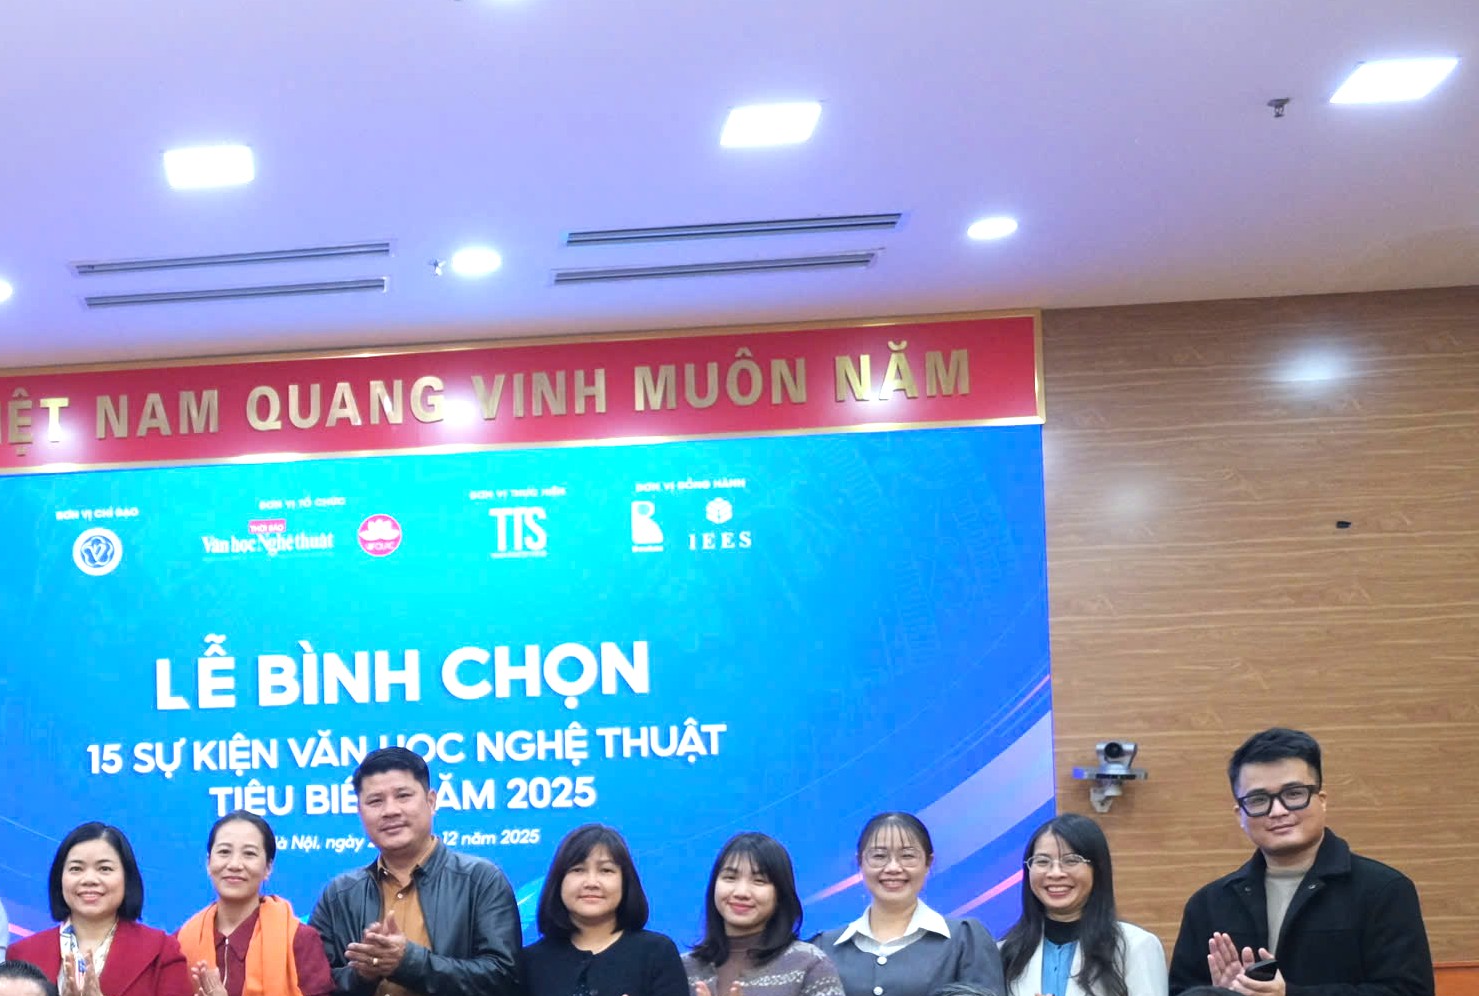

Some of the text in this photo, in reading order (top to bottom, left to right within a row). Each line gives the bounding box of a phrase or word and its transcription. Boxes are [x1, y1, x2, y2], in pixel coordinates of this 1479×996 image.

[96, 389, 218, 440] NAM
[245, 376, 445, 431] QUANG
[471, 368, 606, 420] VINH
[634, 347, 807, 411] MUÔN
[834, 340, 970, 402] NĂM
[155, 632, 649, 710] LỄ BÌNH CHỌN
[87, 744, 122, 774] 15
[133, 738, 186, 779] SỰ
[192, 732, 277, 776] KIỆN
[287, 730, 367, 768] VĂN
[476, 721, 588, 767] NGHỆ
[595, 717, 727, 764] THUẬT
[208, 778, 294, 817] TIÊU
[435, 773, 496, 811] ĂM
[506, 776, 597, 809] 2025
[325, 834, 365, 853] ngày
[461, 832, 496, 845] năm
[500, 828, 540, 845] 2025
